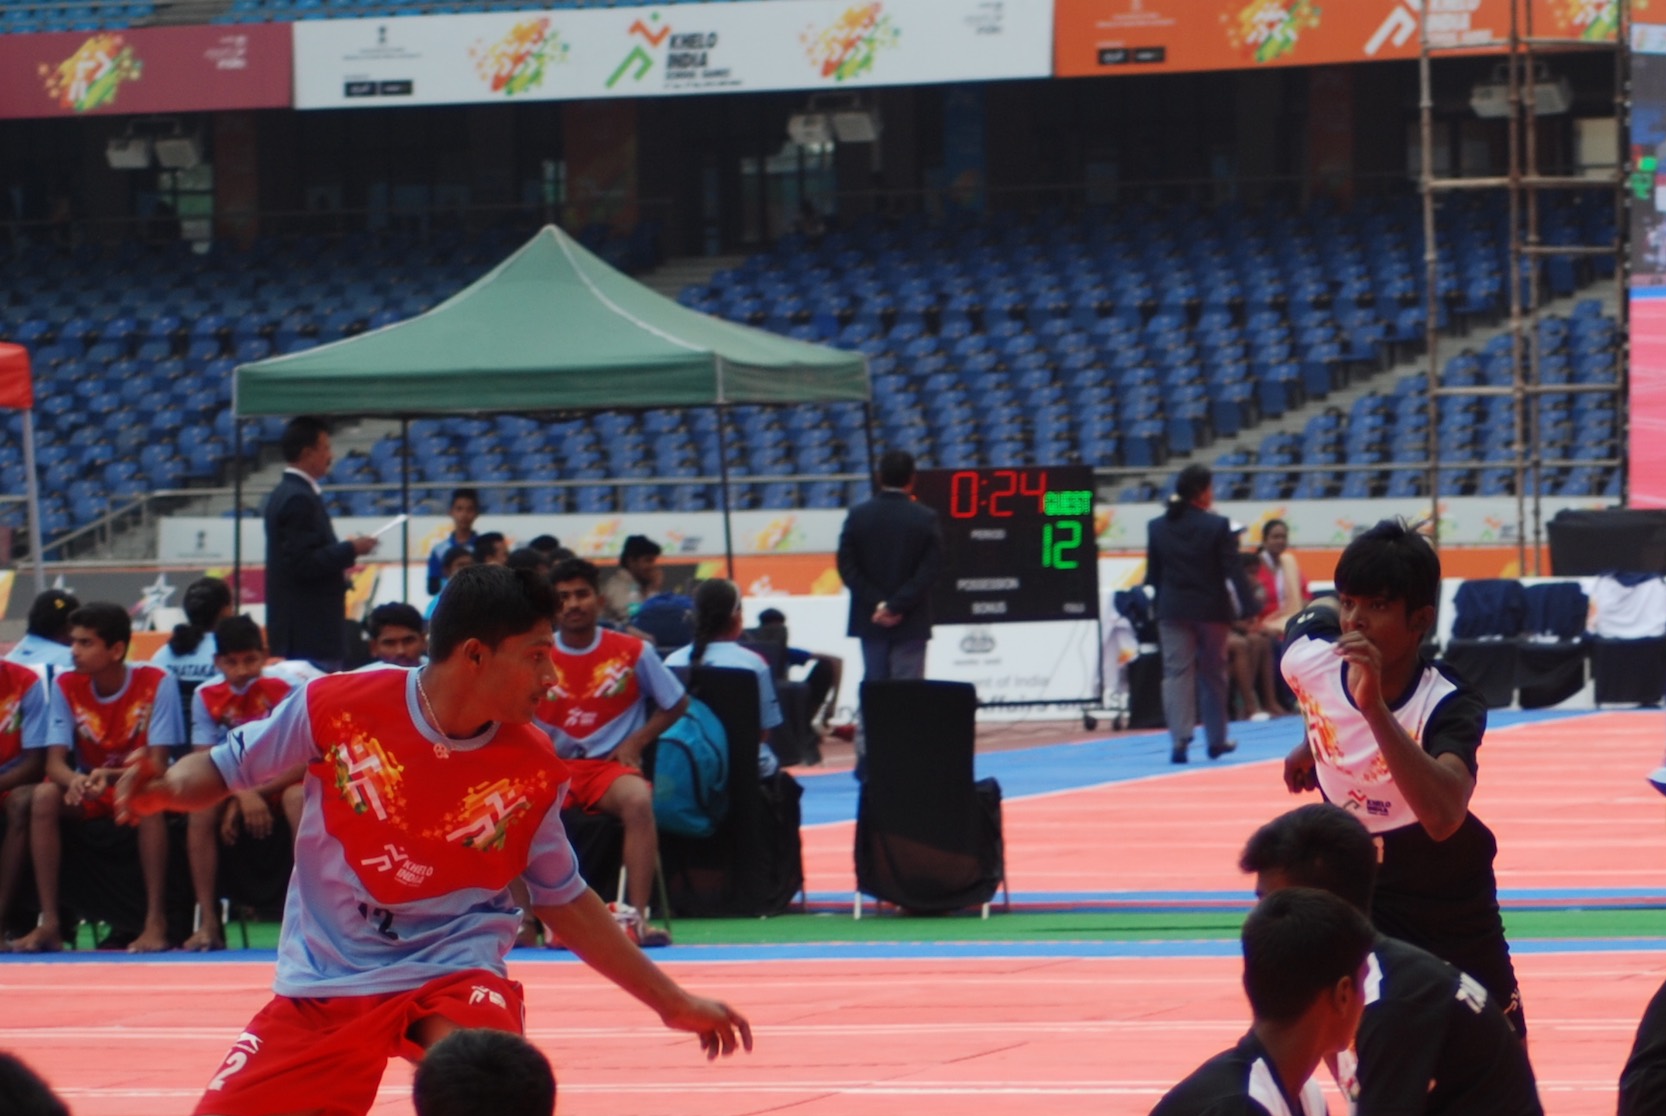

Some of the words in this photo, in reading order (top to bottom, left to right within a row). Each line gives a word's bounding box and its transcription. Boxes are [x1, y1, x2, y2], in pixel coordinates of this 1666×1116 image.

[951, 470, 1047, 518] 0:24
[1042, 520, 1082, 569] 12
[396, 867, 425, 885] INDIA
[402, 860, 434, 876] KHELO
